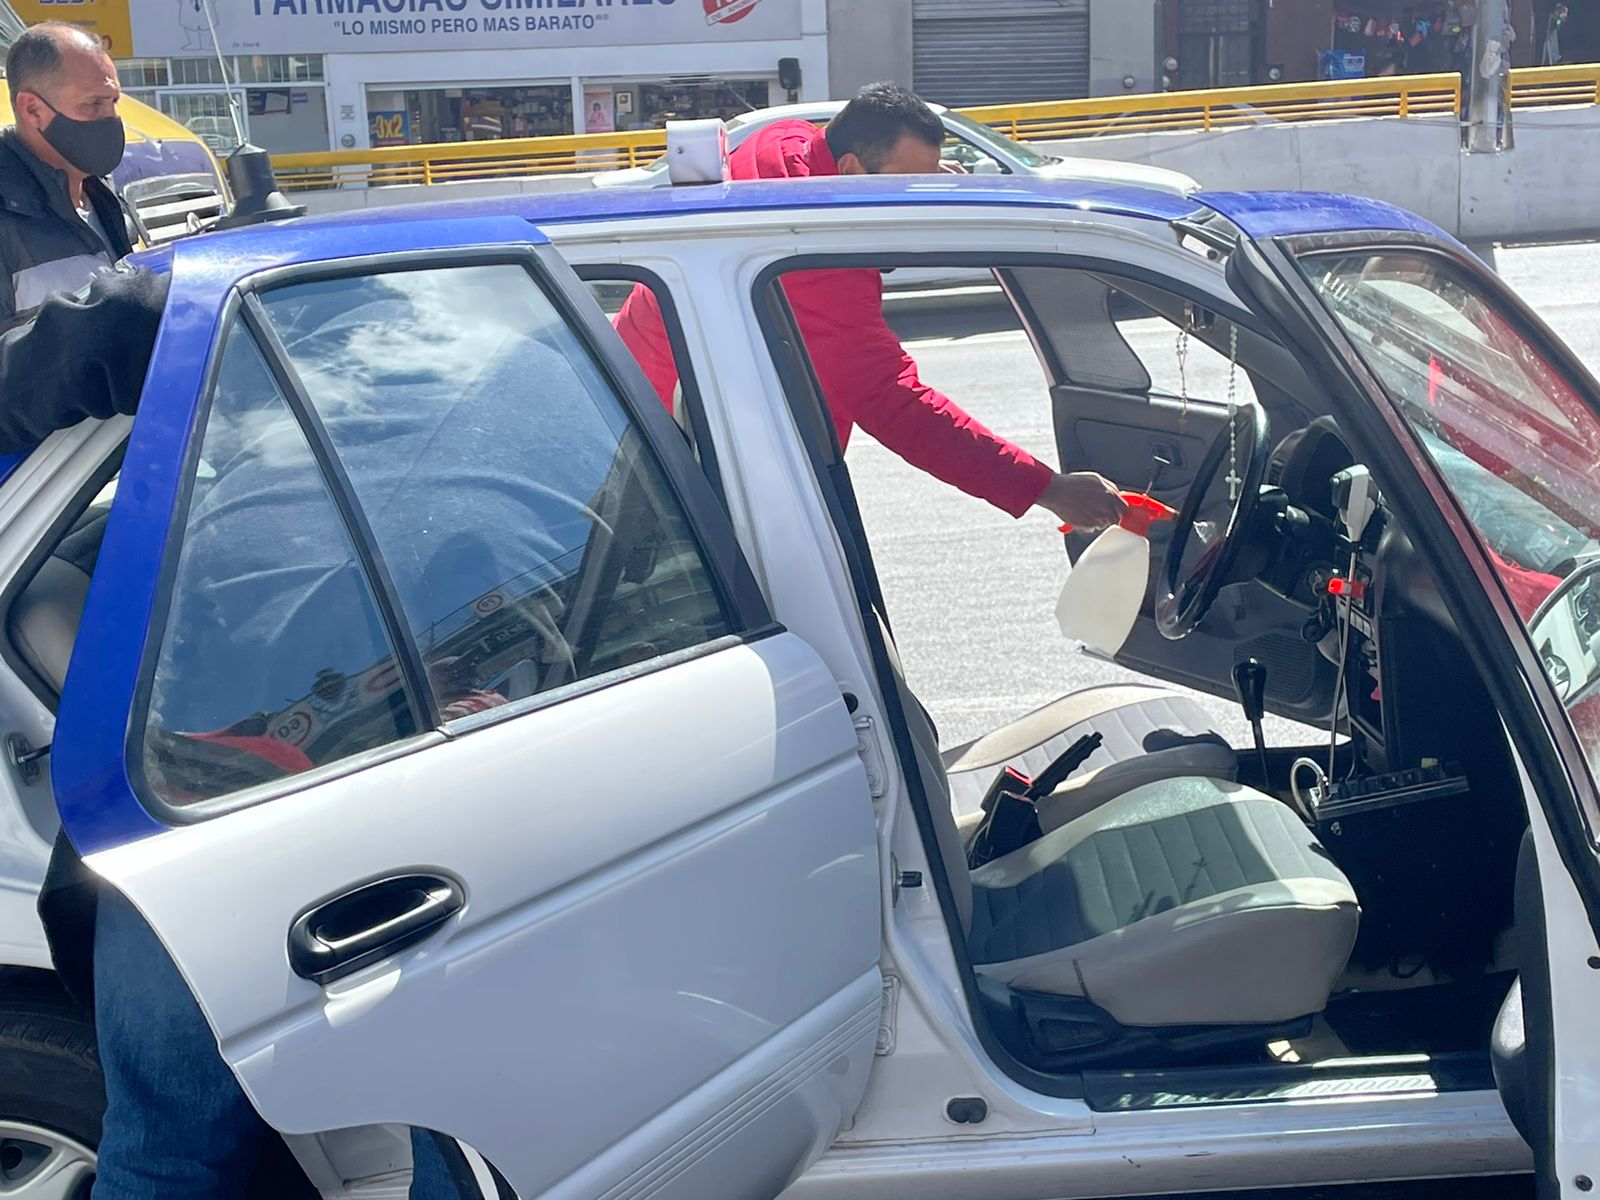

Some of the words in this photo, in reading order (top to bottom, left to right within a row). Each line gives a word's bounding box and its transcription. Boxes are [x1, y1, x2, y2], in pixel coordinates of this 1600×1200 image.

[370, 19, 426, 35] MISMO
[431, 17, 478, 33] PERO
[483, 16, 520, 32] MAS
[375, 113, 404, 139] 3x2
